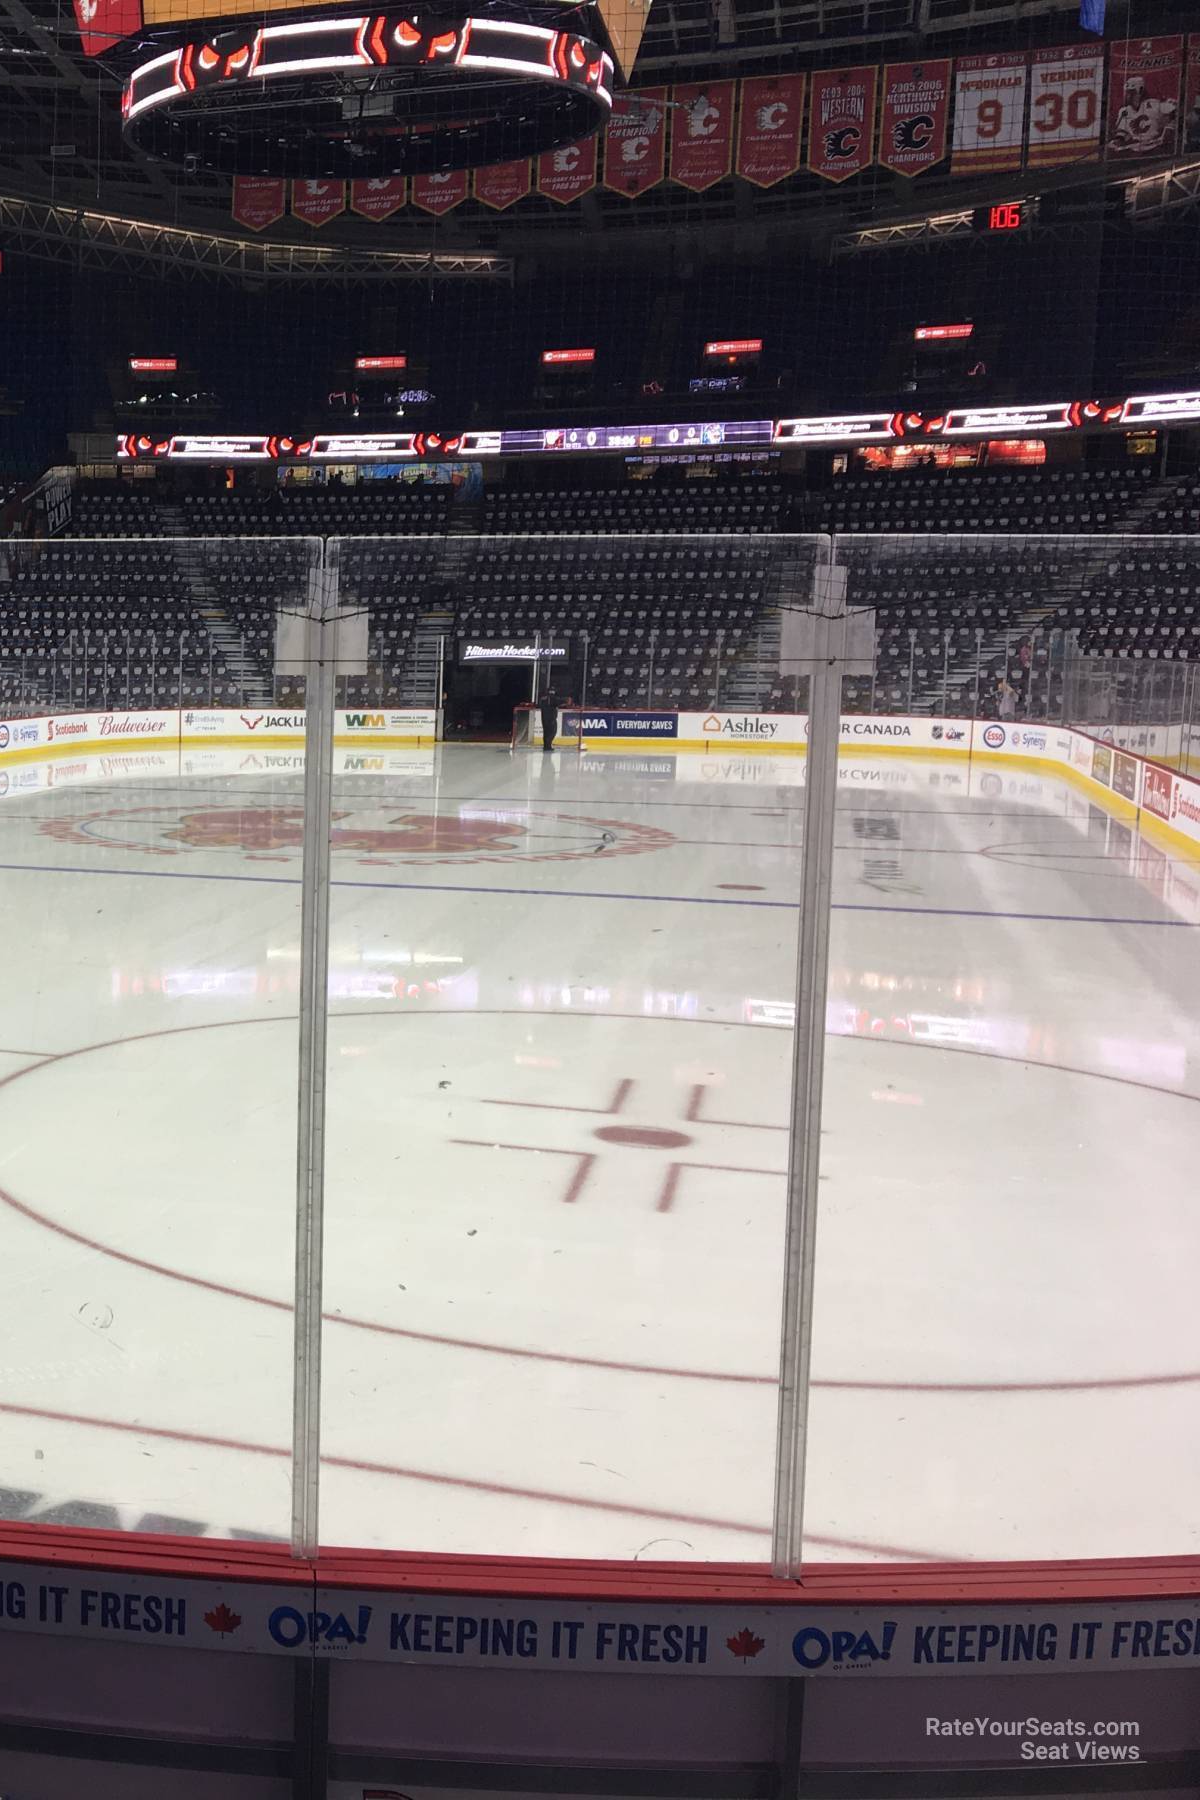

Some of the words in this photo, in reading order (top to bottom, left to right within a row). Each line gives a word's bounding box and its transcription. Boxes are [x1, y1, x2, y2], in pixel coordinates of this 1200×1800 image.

[1141, 41, 1153, 54] 2
[1040, 68, 1095, 83] VERNON
[891, 82, 916, 93] 2005
[917, 80, 942, 90] 2006
[886, 90, 945, 105] NORTHWEST
[821, 98, 864, 126] WESTERN
[893, 101, 937, 115] DIVISION
[1033, 89, 1098, 133] 30
[976, 99, 1003, 139] 9
[887, 152, 936, 164] CHAMPIONS
[586, 430, 597, 446] 0
[668, 428, 679, 443] 0
[464, 645, 566, 661] HitmenHockey.com
[98, 716, 167, 734] Budweiser
[264, 716, 292, 728] JACK
[294, 716, 307, 727] LI
[346, 714, 385, 726] WM
[578, 719, 607, 729] AMA
[617, 720, 649, 730] EVERYDAY
[651, 720, 672, 730] SAVES
[722, 717, 778, 738] Ashley
[20, 729, 38, 741] Synergy
[55, 721, 88, 735] Scotiabank
[853, 724, 911, 737] CANADA
[987, 731, 1002, 741] Esso
[1022, 733, 1046, 750] Synergy
[39, 1585, 69, 1623] IT
[80, 1590, 187, 1636] FRESH
[268, 1605, 372, 1648] OPA!
[389, 1612, 538, 1657] KEEPING
[551, 1621, 585, 1659] IT
[596, 1622, 708, 1664] FRESH
[791, 1621, 898, 1669] OPA!
[913, 1622, 1058, 1664] KEEPING
[1069, 1622, 1102, 1660] IT
